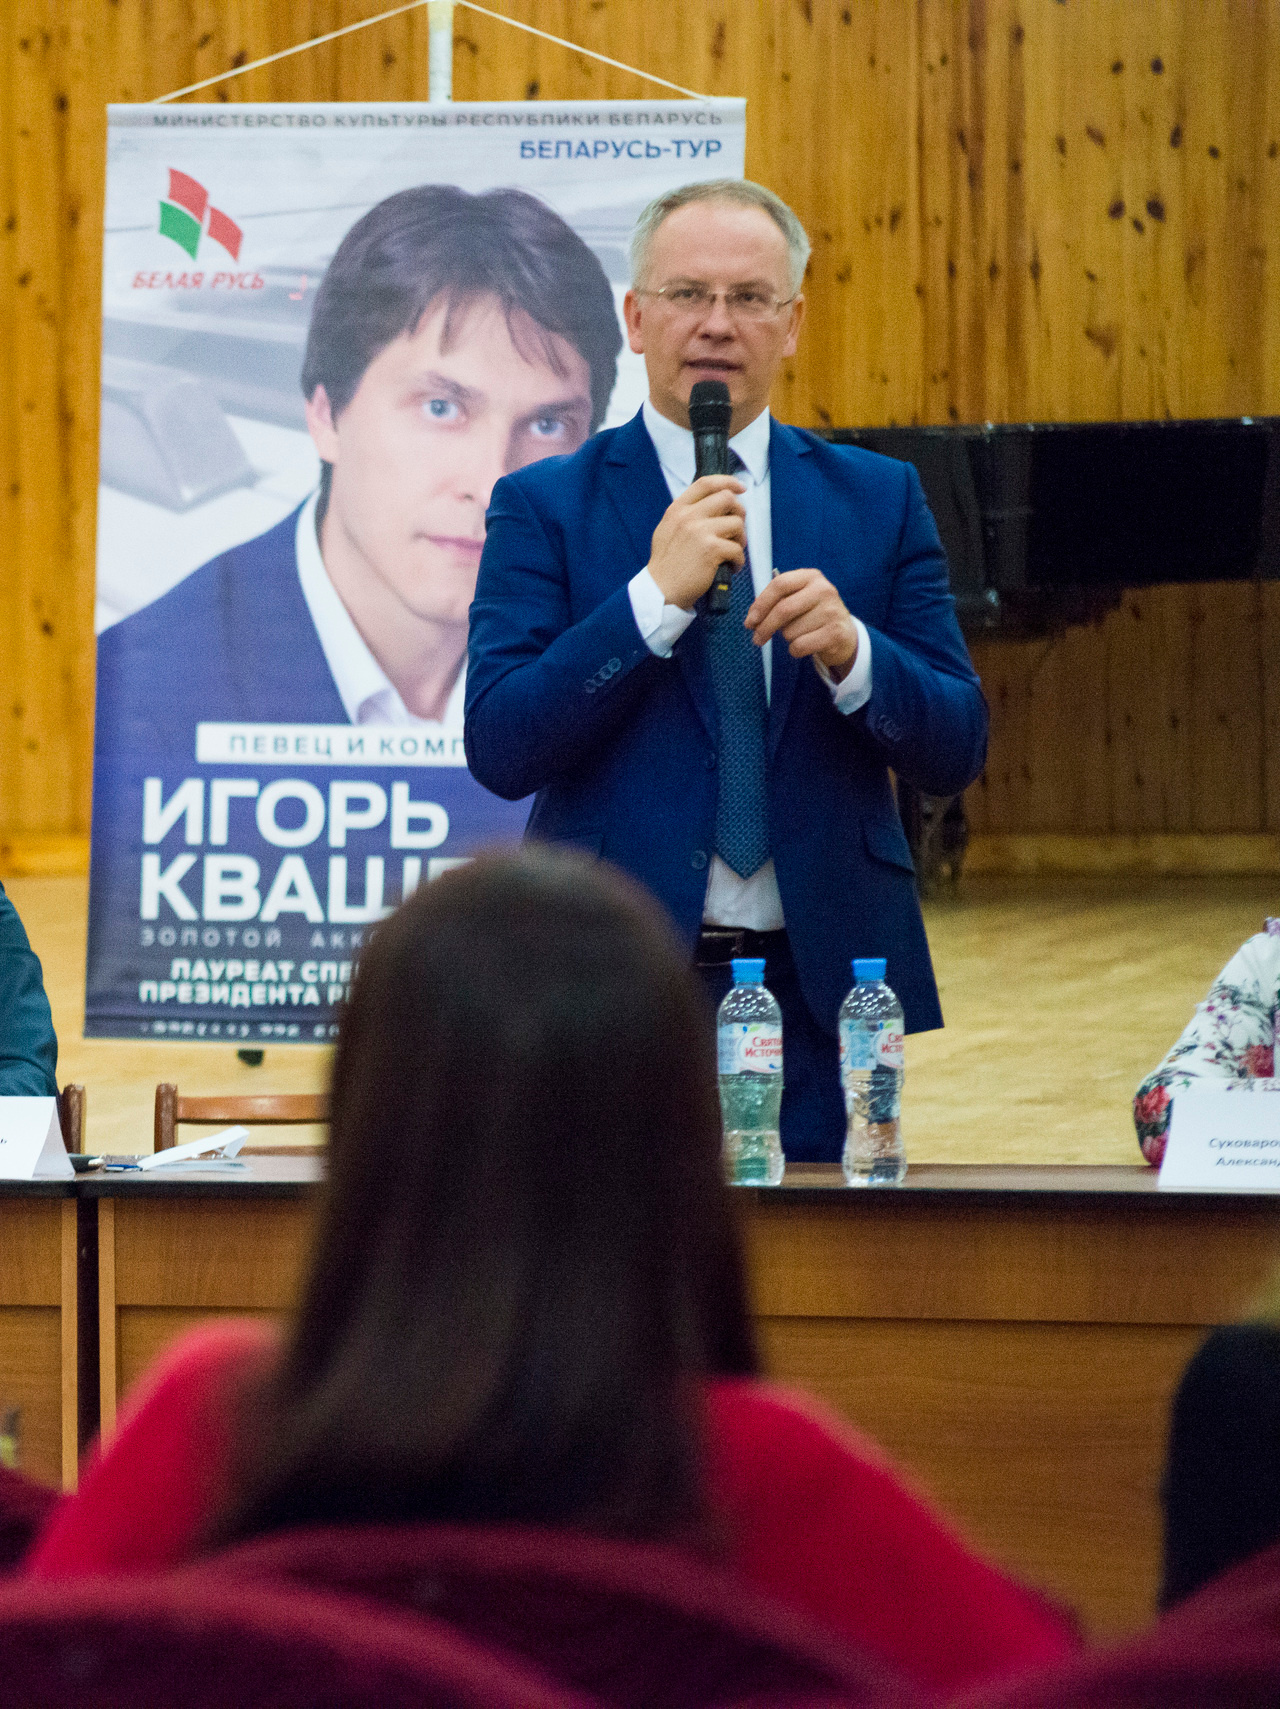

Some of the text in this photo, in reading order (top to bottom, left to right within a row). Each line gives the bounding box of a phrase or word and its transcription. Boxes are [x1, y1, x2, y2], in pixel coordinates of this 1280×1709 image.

[153, 114, 326, 127] МИНИСТЕРСТВО
[456, 113, 600, 126] РЕСПУБЛИКИ
[609, 112, 722, 126] БЕЛАРУСЬ
[519, 139, 723, 159] БЕЛАРУСЬ-ТУР
[132, 271, 265, 290] БЕЛАЯ РУСЬ
[230, 734, 332, 758] ПЕВЕЦ
[347, 737, 365, 755] И
[142, 777, 450, 850] ИГОРЬ
[141, 925, 376, 949] ЗОЛОТОЙ АКК
[170, 958, 295, 982] ЛАУРЕАТ
[139, 980, 320, 1008] ПРЕЗИДЕНТА
[1209, 1138, 1280, 1149] Суховаро
